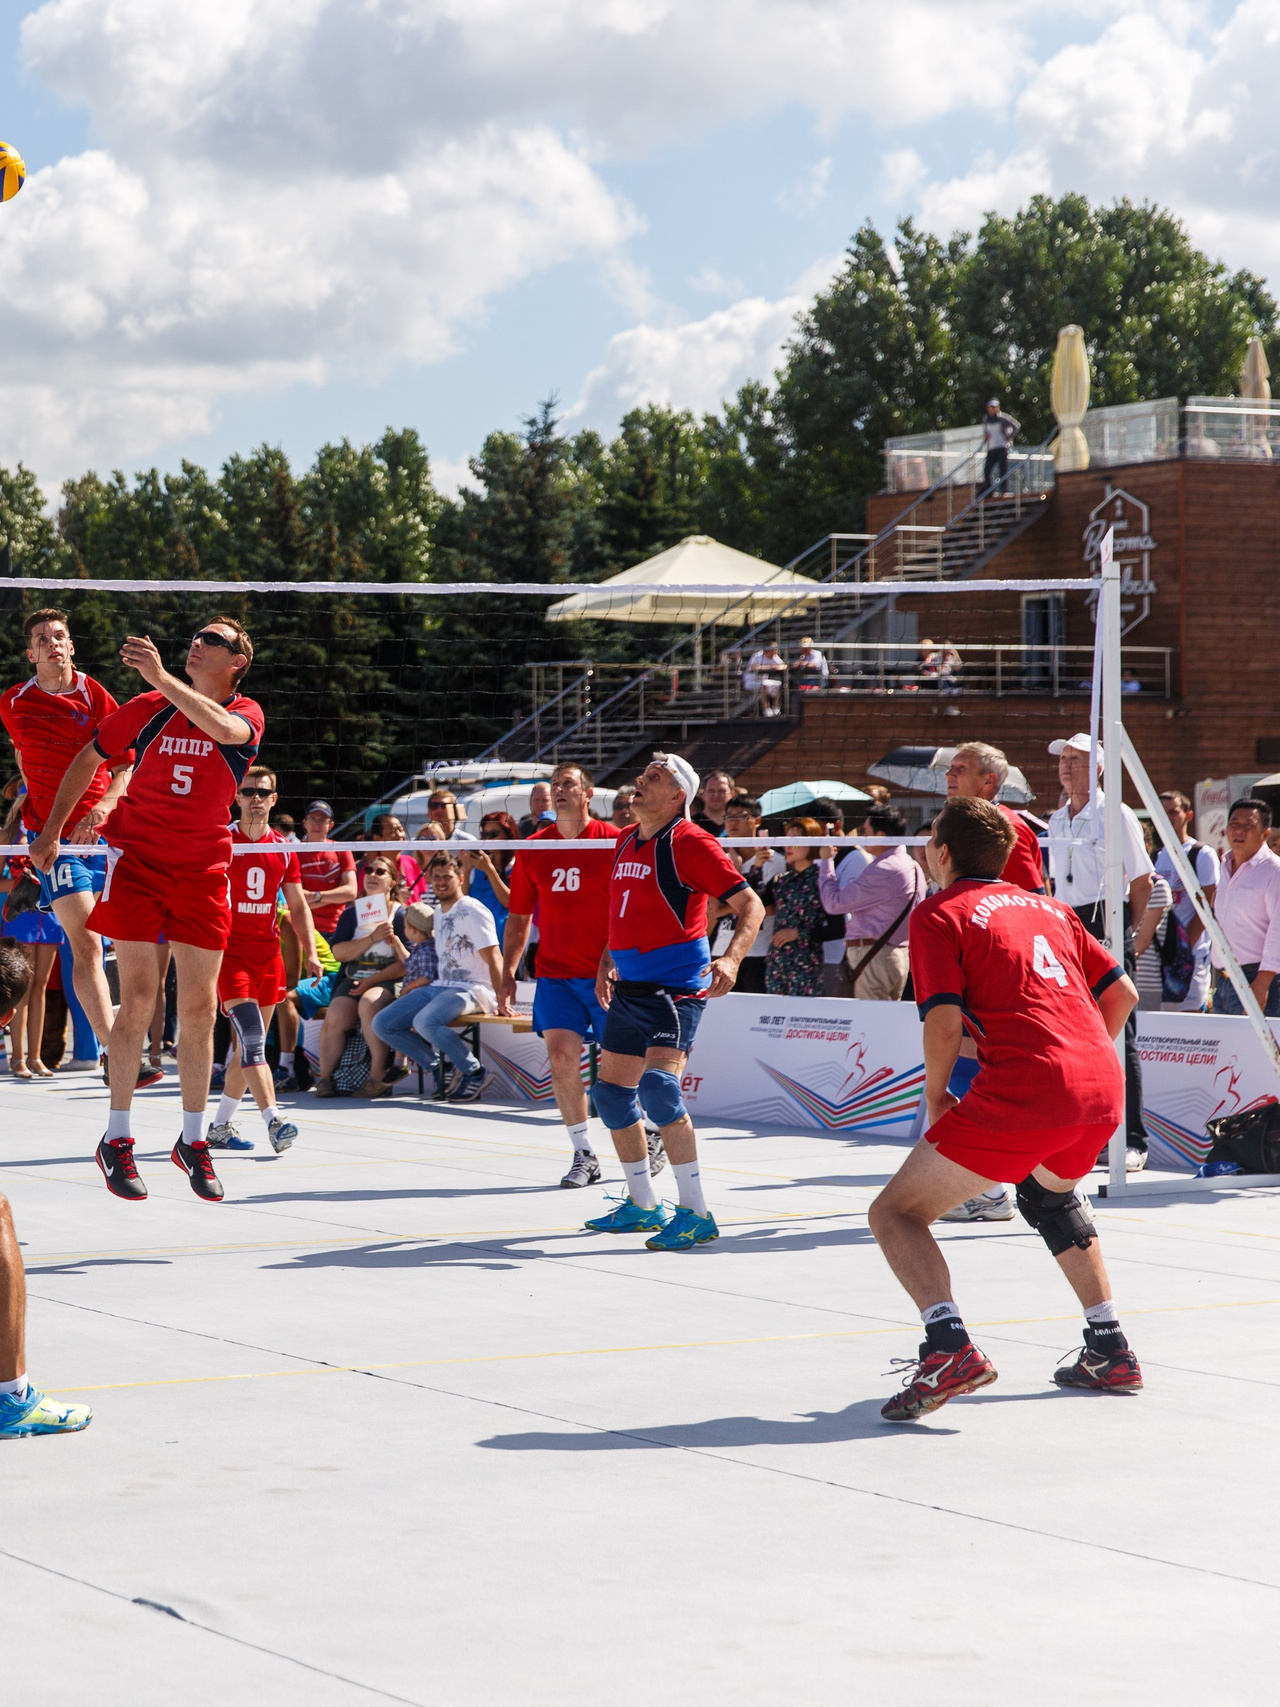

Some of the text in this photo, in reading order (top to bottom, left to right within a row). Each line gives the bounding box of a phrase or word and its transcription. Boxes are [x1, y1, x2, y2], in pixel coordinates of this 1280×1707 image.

[159, 736, 214, 757] ДППР
[170, 764, 194, 796] 5
[47, 863, 74, 893] 14
[246, 866, 266, 900] 9
[551, 867, 581, 892] 26
[614, 862, 652, 880] ДППР
[238, 902, 272, 914] МАГНИТ
[619, 889, 630, 918] 1
[1033, 934, 1069, 988] 4
[786, 1029, 825, 1040] ДОСТИГАЯ
[1186, 1054, 1217, 1065] ЦЕЛИ!
